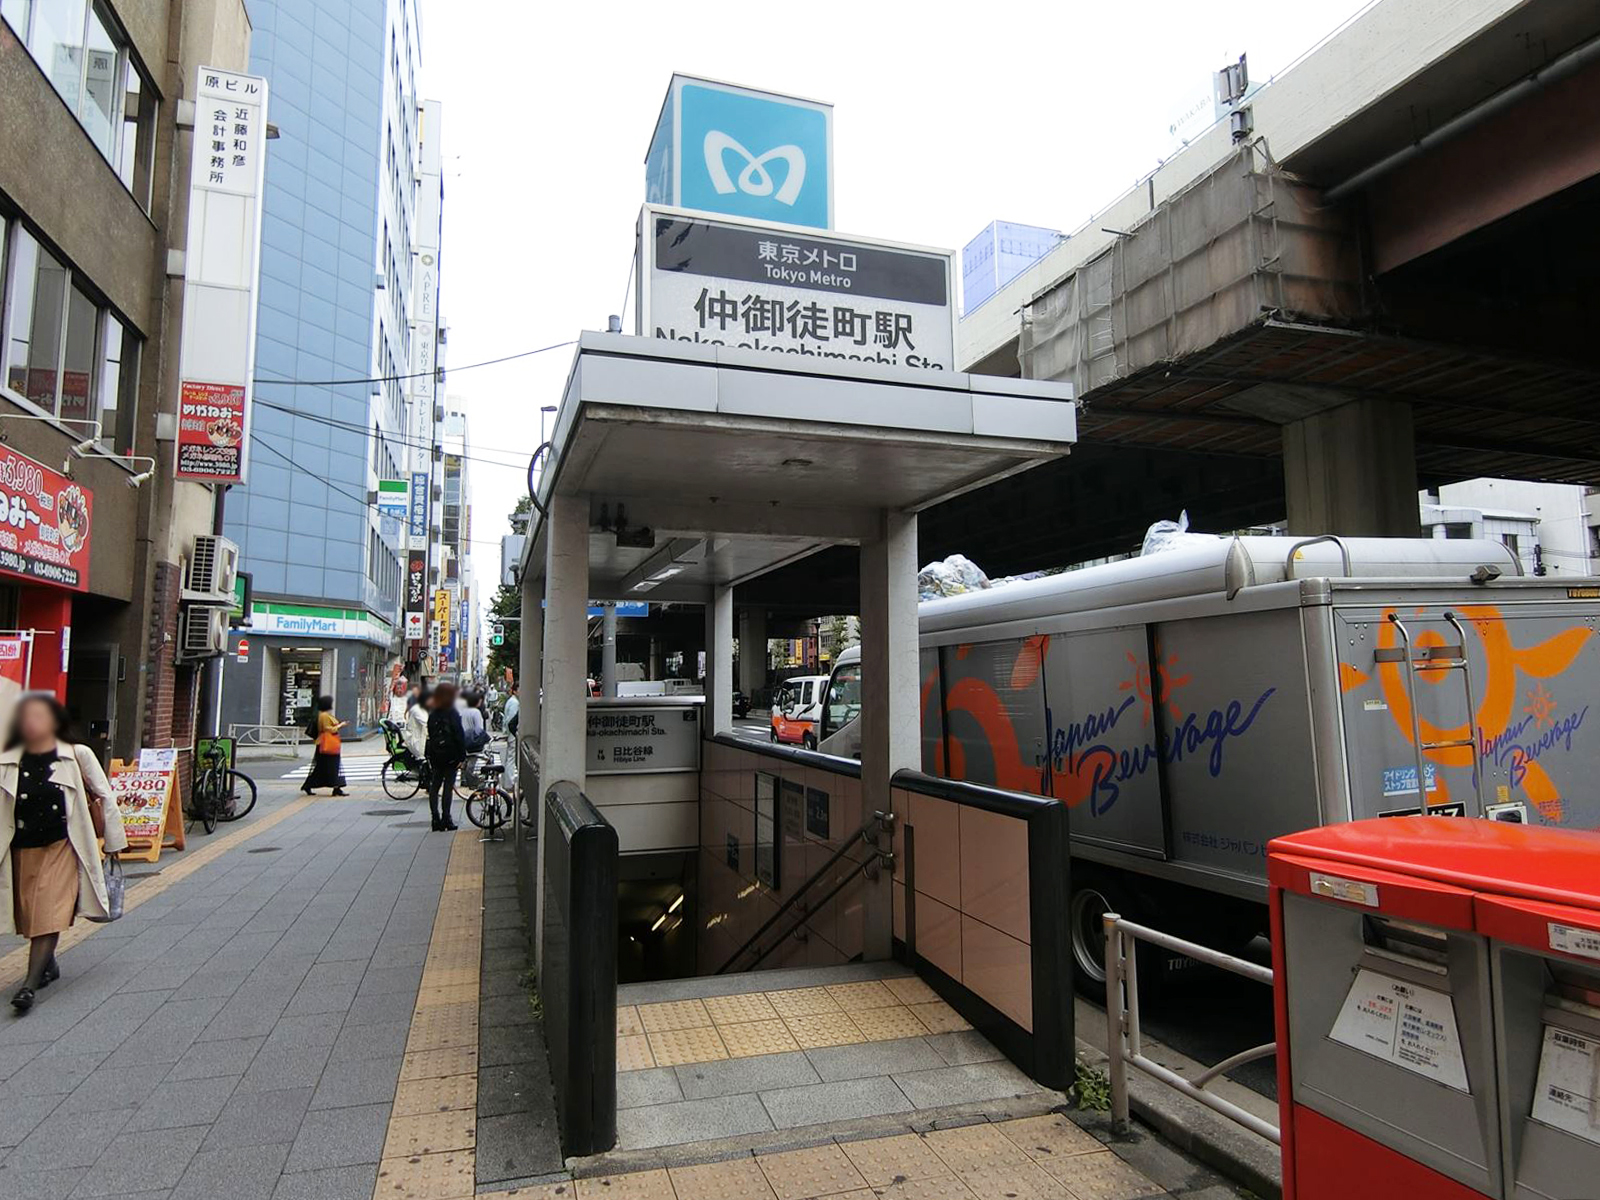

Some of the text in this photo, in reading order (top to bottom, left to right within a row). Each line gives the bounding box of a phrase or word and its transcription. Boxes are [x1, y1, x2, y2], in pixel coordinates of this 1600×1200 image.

[205, 75, 258, 94] 原ビル
[209, 109, 227, 184] 会計事務所
[232, 107, 248, 167] 近藤和彦
[758, 241, 856, 271] 東京メトロ
[764, 263, 851, 288] Tokyo Metro
[422, 271, 432, 314] APRE
[694, 287, 916, 350] 仲御徒町駅
[276, 616, 337, 633] FamilyMart
[283, 662, 298, 725] FamilyMart
[588, 715, 655, 728] 仲御徒町駅
[614, 746, 653, 756] 日比谷線
[1076, 687, 1277, 818] Beverage
[1472, 716, 1533, 790] Japan
[1500, 706, 1588, 789] Beverage
